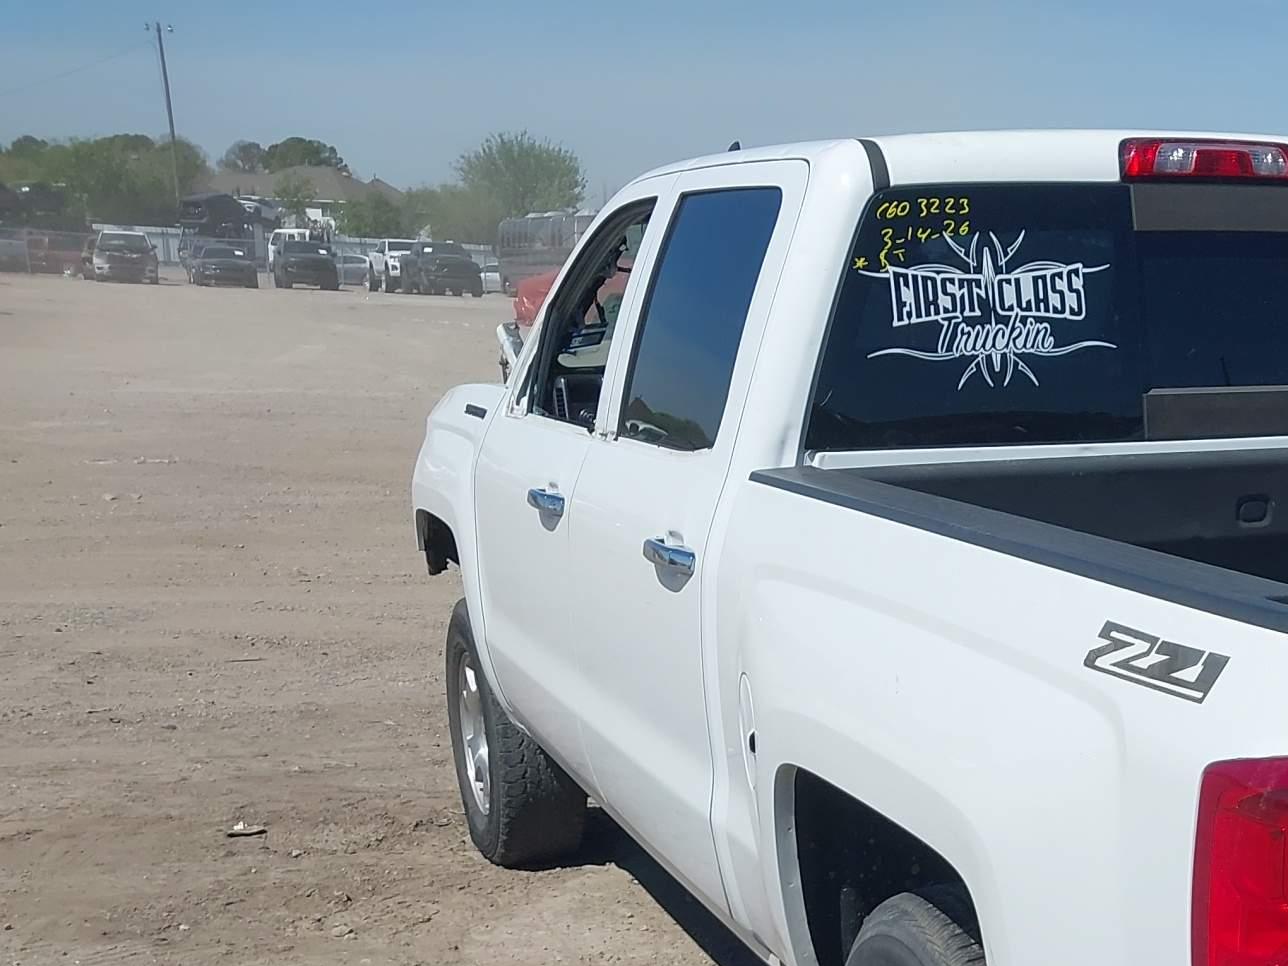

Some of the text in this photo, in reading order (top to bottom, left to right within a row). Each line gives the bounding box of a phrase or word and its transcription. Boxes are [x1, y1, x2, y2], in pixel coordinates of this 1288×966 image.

[889, 262, 1087, 327] FIRST CLASS
[937, 313, 1055, 358] Truckin
